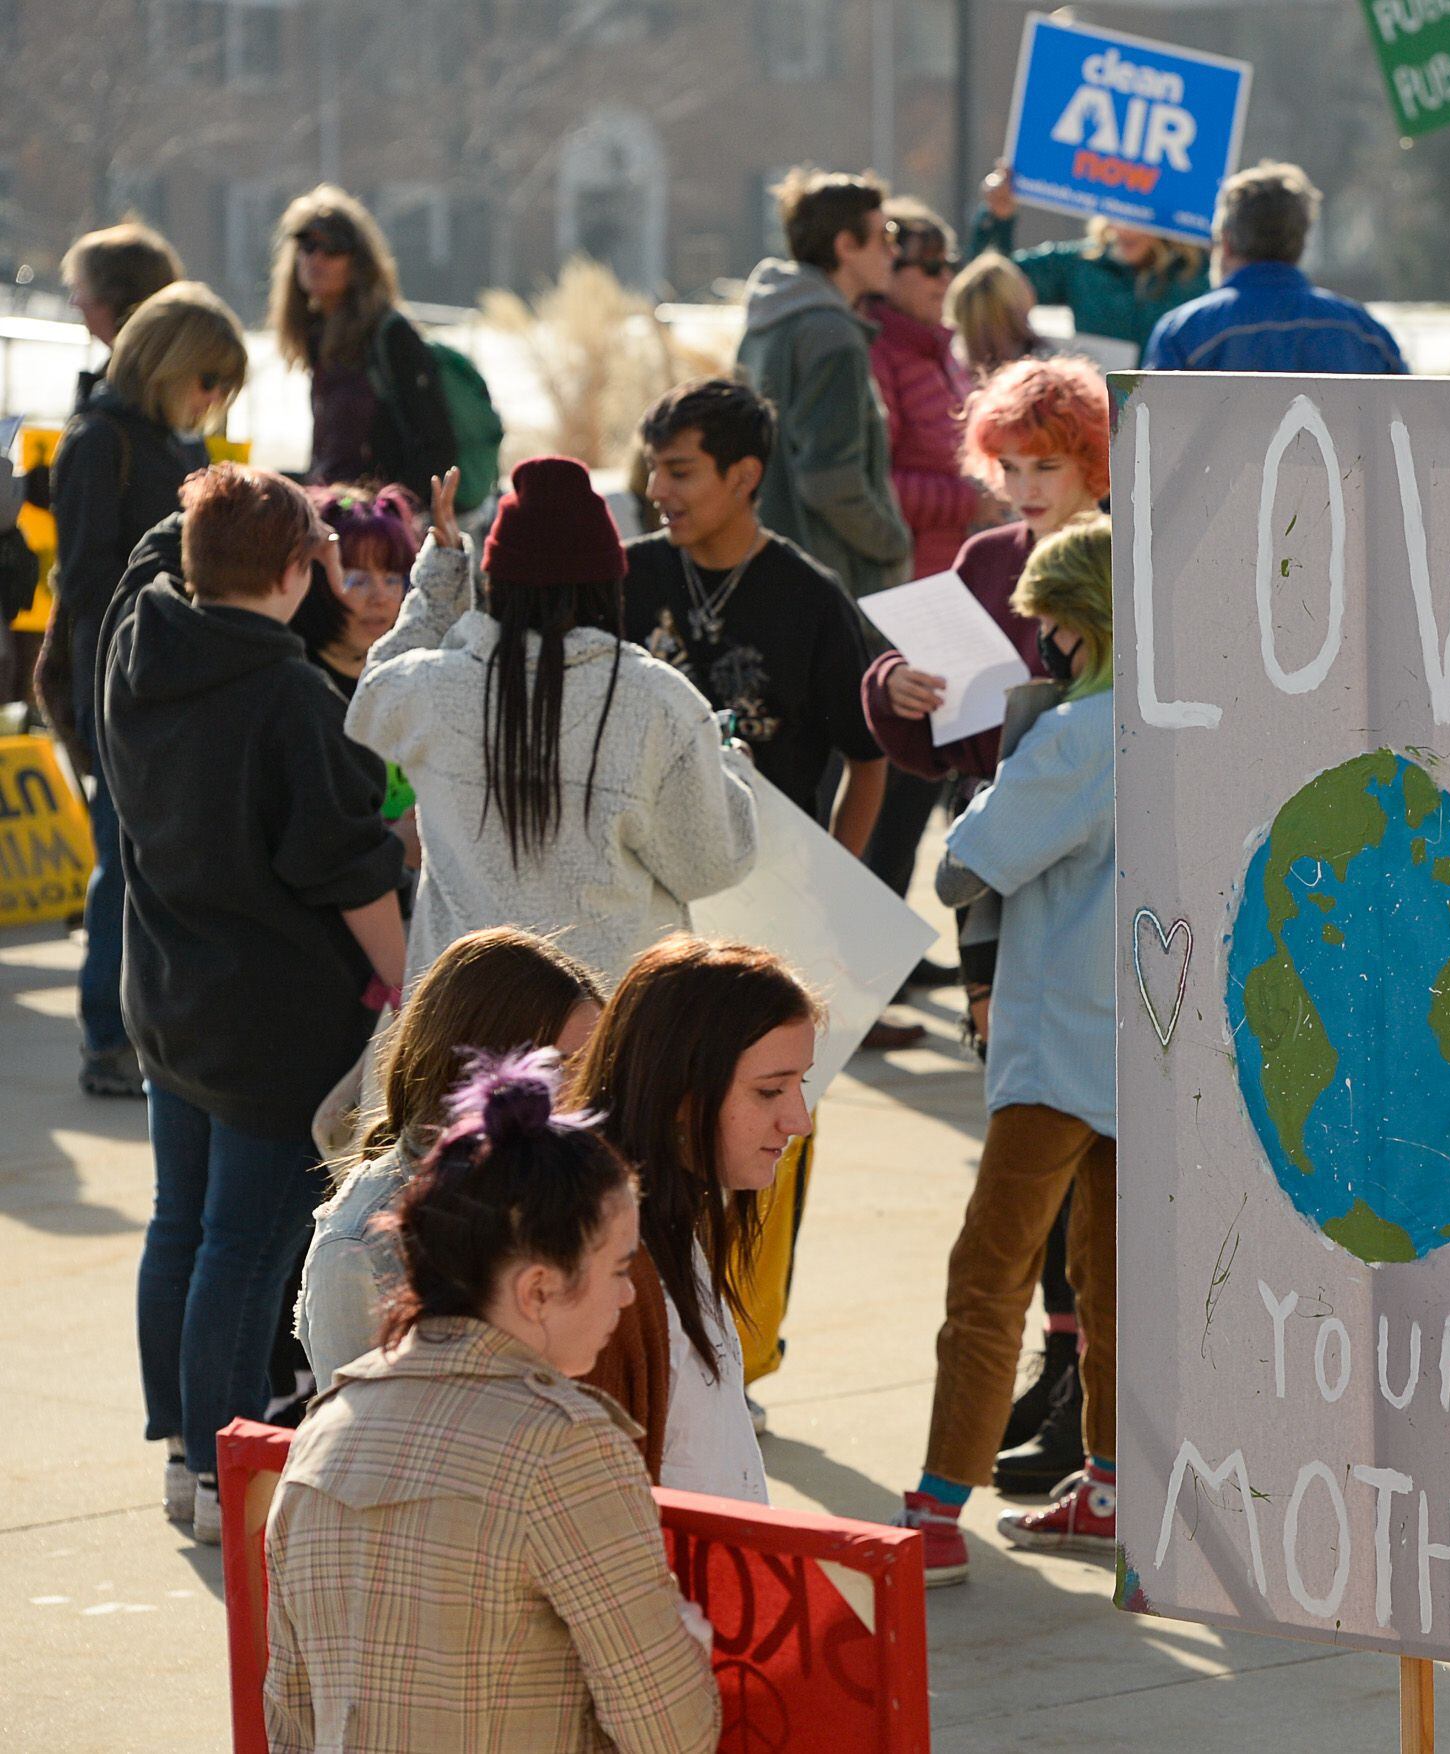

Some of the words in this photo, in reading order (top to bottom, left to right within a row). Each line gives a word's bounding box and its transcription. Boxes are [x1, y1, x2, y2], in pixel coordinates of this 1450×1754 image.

[1082, 48, 1184, 103] clean
[1052, 83, 1197, 172] AIR
[1073, 148, 1161, 194] now
